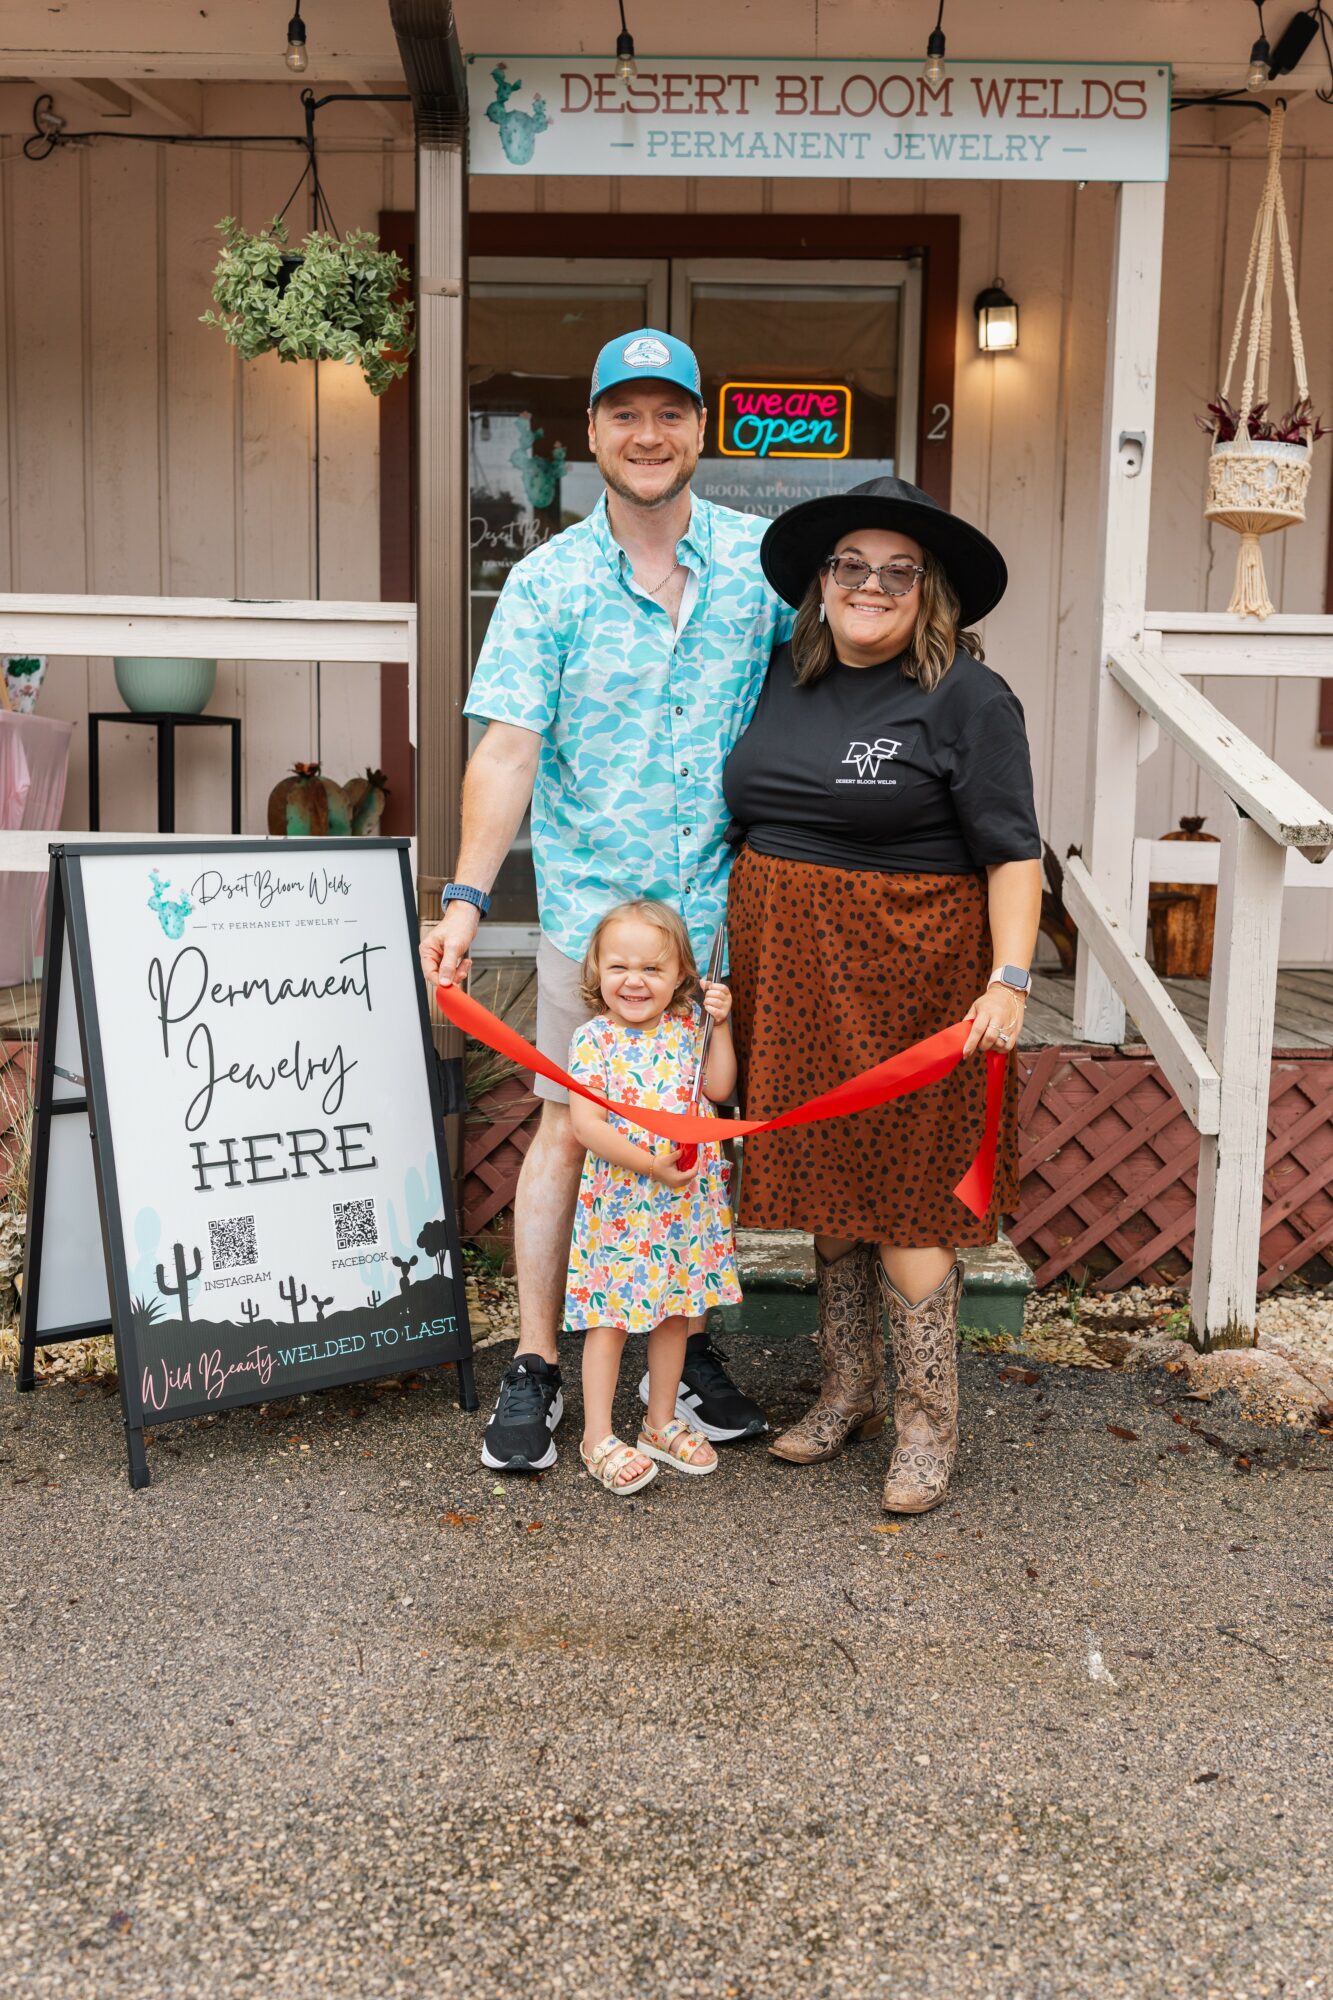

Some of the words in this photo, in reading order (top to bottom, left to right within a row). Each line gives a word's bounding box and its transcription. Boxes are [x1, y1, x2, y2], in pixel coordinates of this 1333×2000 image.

[560, 72, 759, 115] DESERT
[775, 74, 954, 118] BLOOM
[970, 77, 1148, 120] WELDS
[647, 130, 871, 159] PERMANENT
[884, 133, 1051, 161] JEWELRY
[732, 414, 838, 457] Open
[927, 403, 951, 440] 2
[705, 484, 750, 498] BOOK
[191, 870, 253, 905] Desert
[254, 869, 304, 908] Bloom
[309, 867, 351, 904] Welds
[211, 923, 225, 931] TX
[229, 920, 291, 930] PERMANENT
[295, 918, 340, 928] JEWELRY
[148, 942, 386, 1058] Permanent
[185, 1023, 358, 1131] Jewelry
[189, 1122, 377, 1192] HERE
[204, 1271, 272, 1291] INSTAGRAM
[331, 1252, 389, 1270] FACEBOOK
[142, 1358, 192, 1410] Wild
[278, 1335, 366, 1366] WELDED
[371, 1328, 399, 1347] TO
[404, 1316, 458, 1342] LAST.
